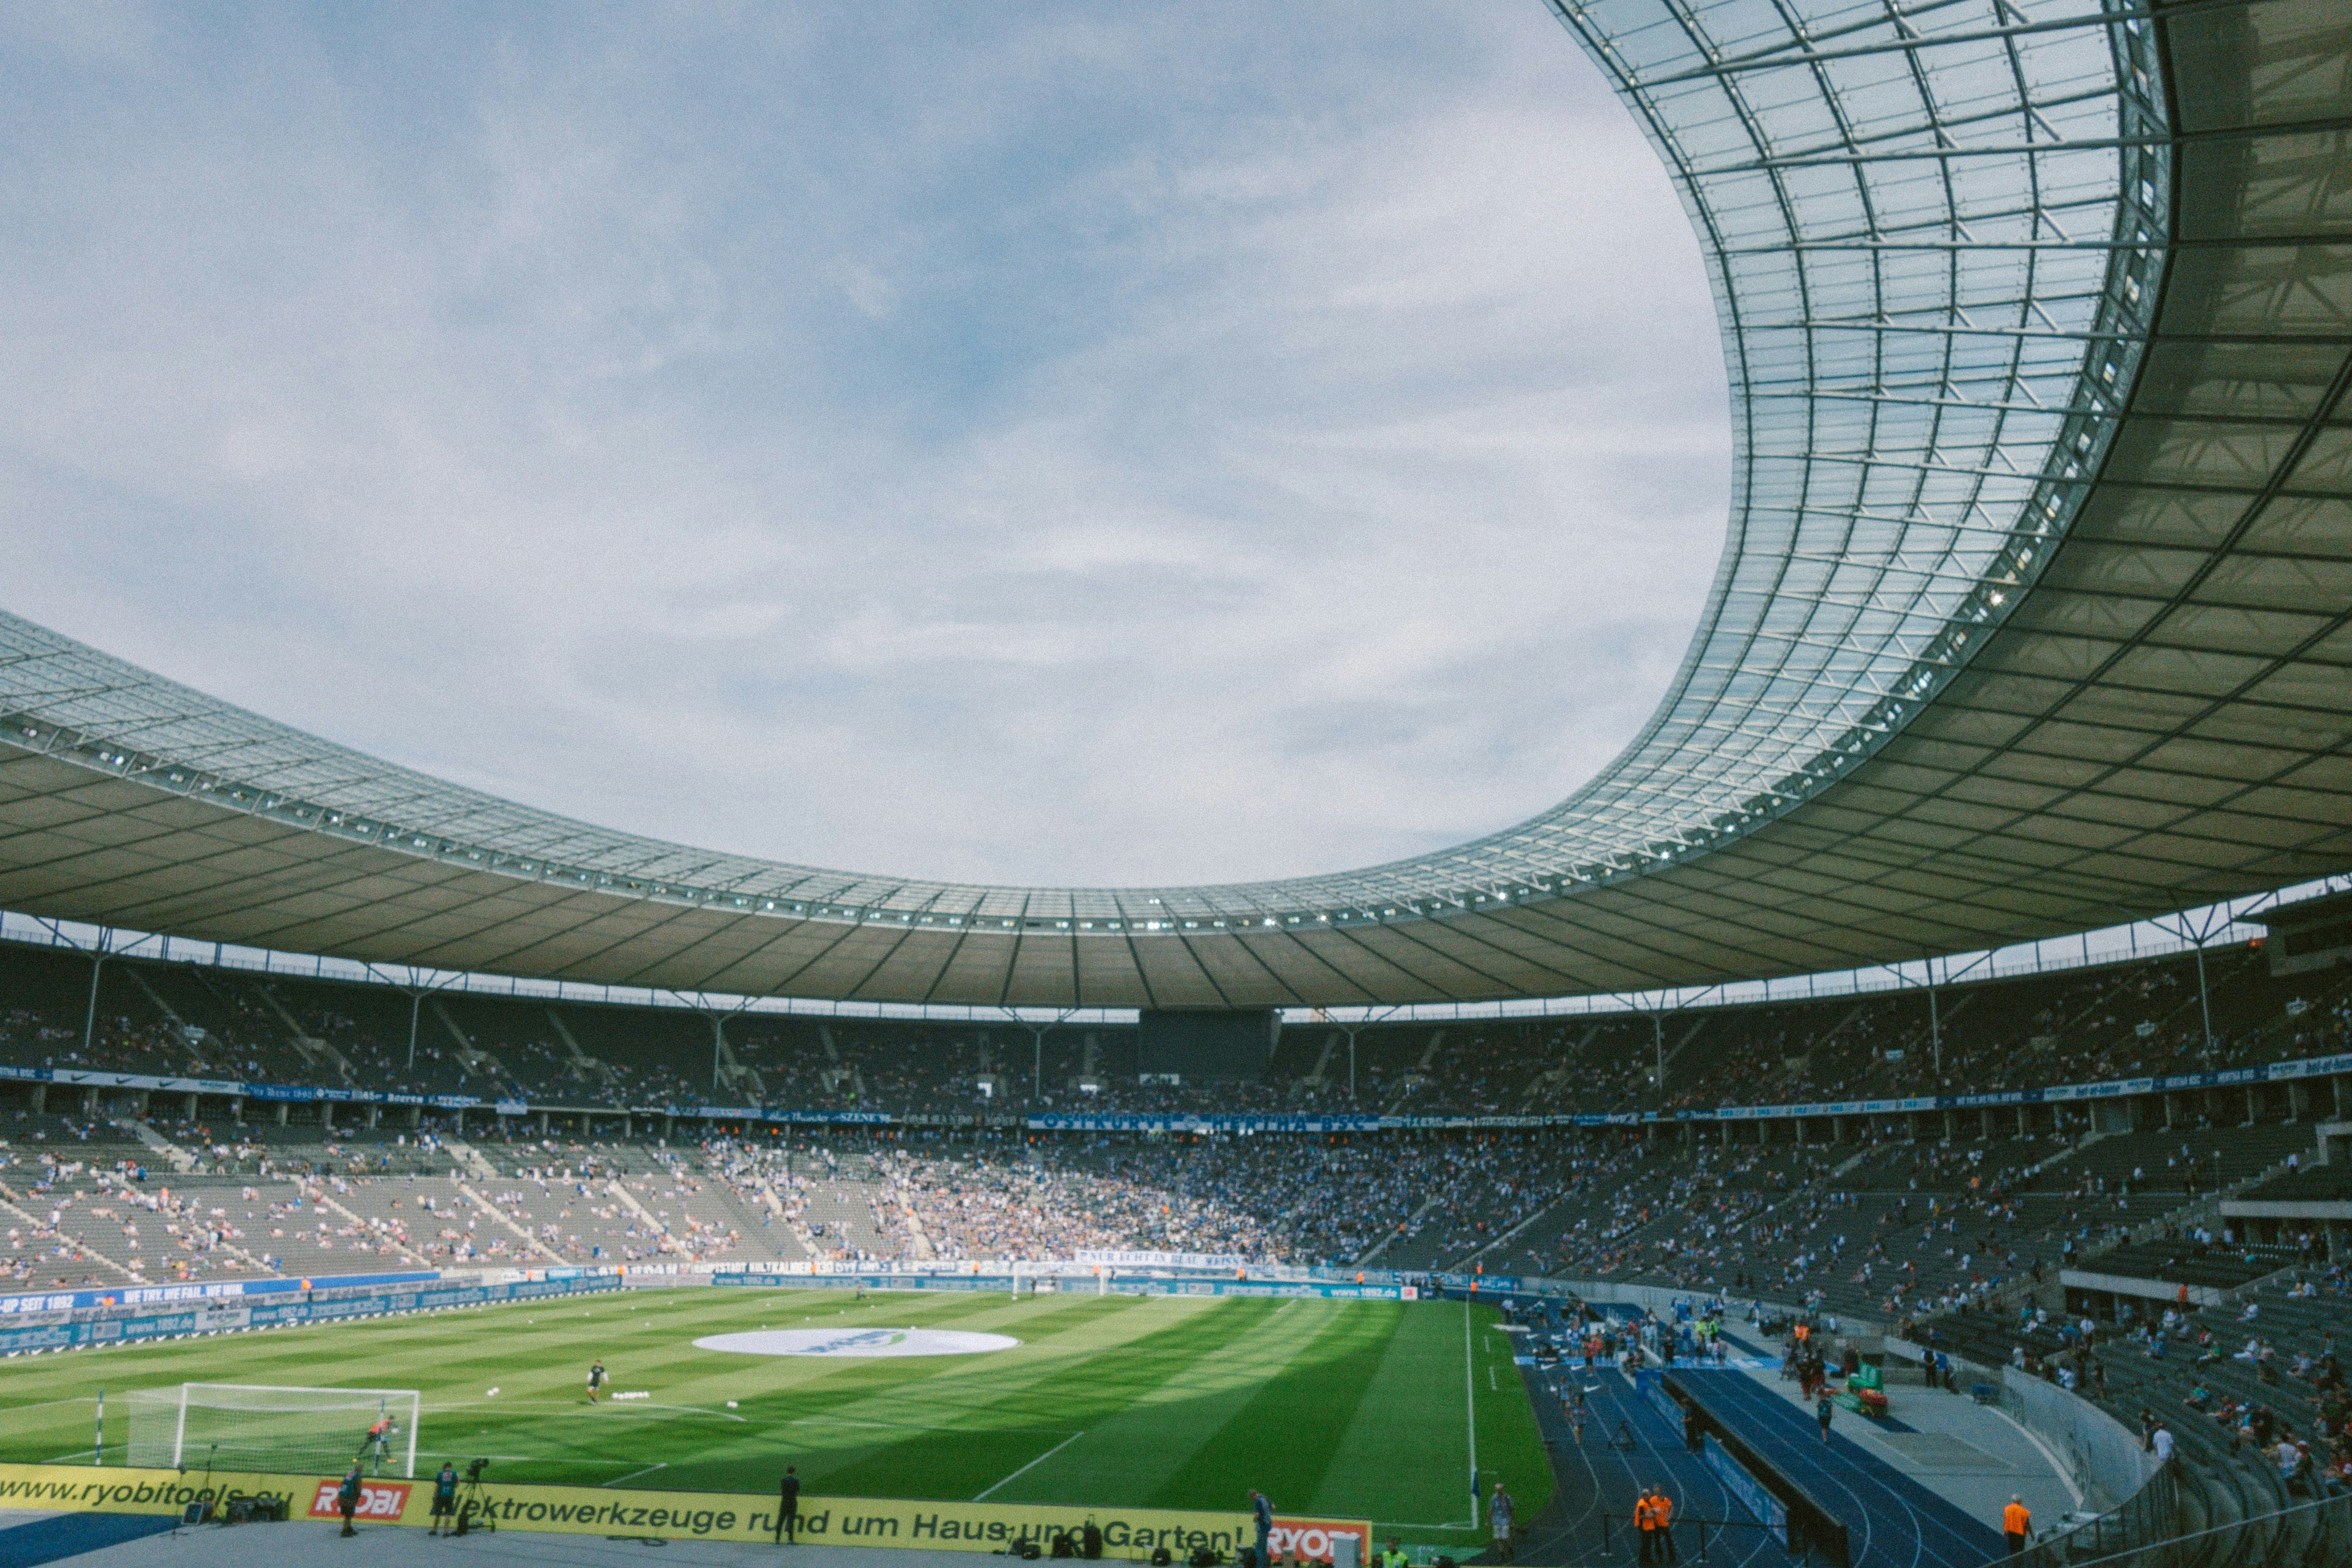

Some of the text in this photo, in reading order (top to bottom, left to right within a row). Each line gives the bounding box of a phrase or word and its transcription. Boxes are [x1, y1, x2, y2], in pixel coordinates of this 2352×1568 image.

[1043, 1113, 1172, 1130] OSTKURVE
[1211, 1114, 1307, 1131] HERTHA
[1320, 1115, 1366, 1131] BSC
[124, 1289, 141, 1303] WE
[164, 1287, 181, 1301] WE
[206, 1285, 222, 1297] WE
[1330, 1287, 1397, 1299] www.1892.de
[20, 1296, 46, 1312] SEIT
[48, 1294, 74, 1310] 1892
[315, 1486, 402, 1516] ROBI
[431, 1493, 736, 1535] lektrowerkzeuge
[747, 1509, 830, 1535] rund
[842, 1514, 899, 1537] um
[913, 1513, 1007, 1541] Haus
[1104, 1520, 1243, 1551] Garten!
[1267, 1527, 1361, 1558] RYO
